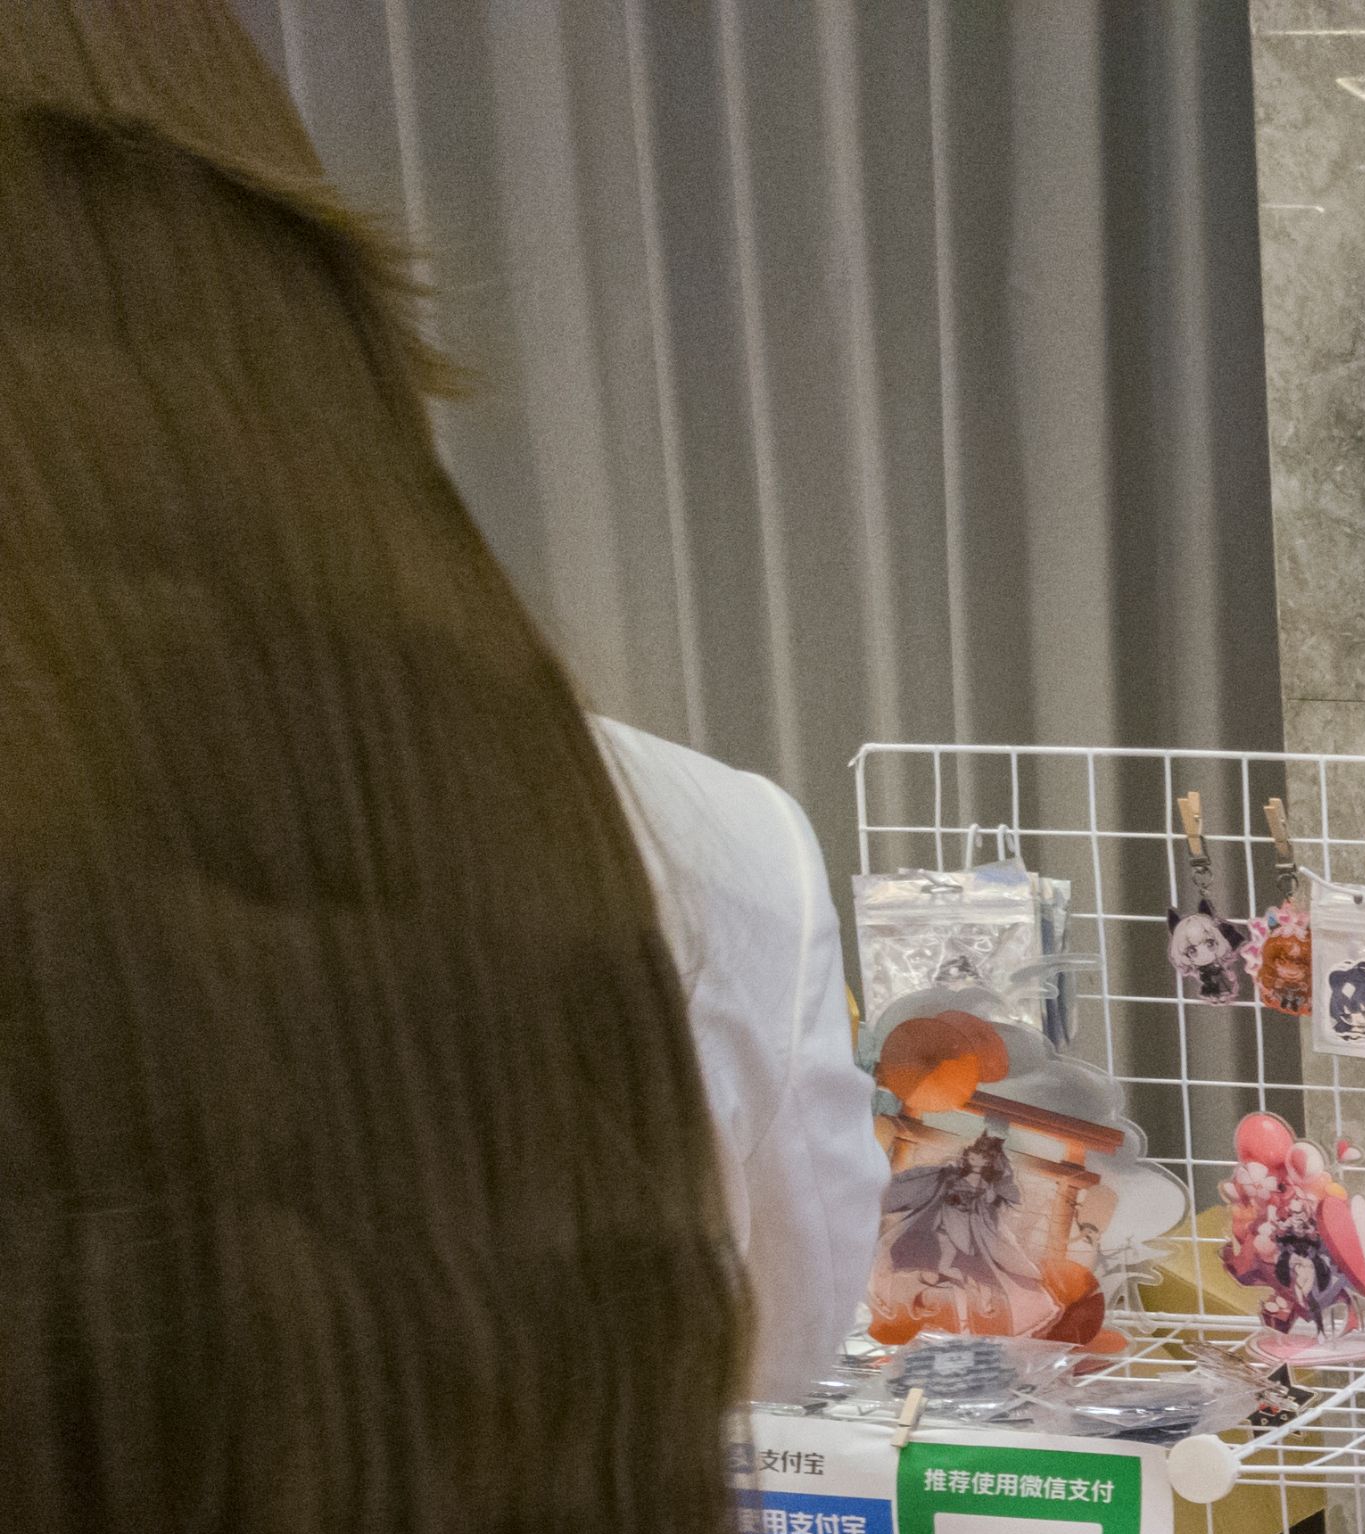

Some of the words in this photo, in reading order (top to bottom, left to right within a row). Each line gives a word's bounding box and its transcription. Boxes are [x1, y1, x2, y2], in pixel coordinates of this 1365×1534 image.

[759, 1448, 826, 1477] 支付宝
[923, 1468, 1115, 1505] 推荐使用微信支付
